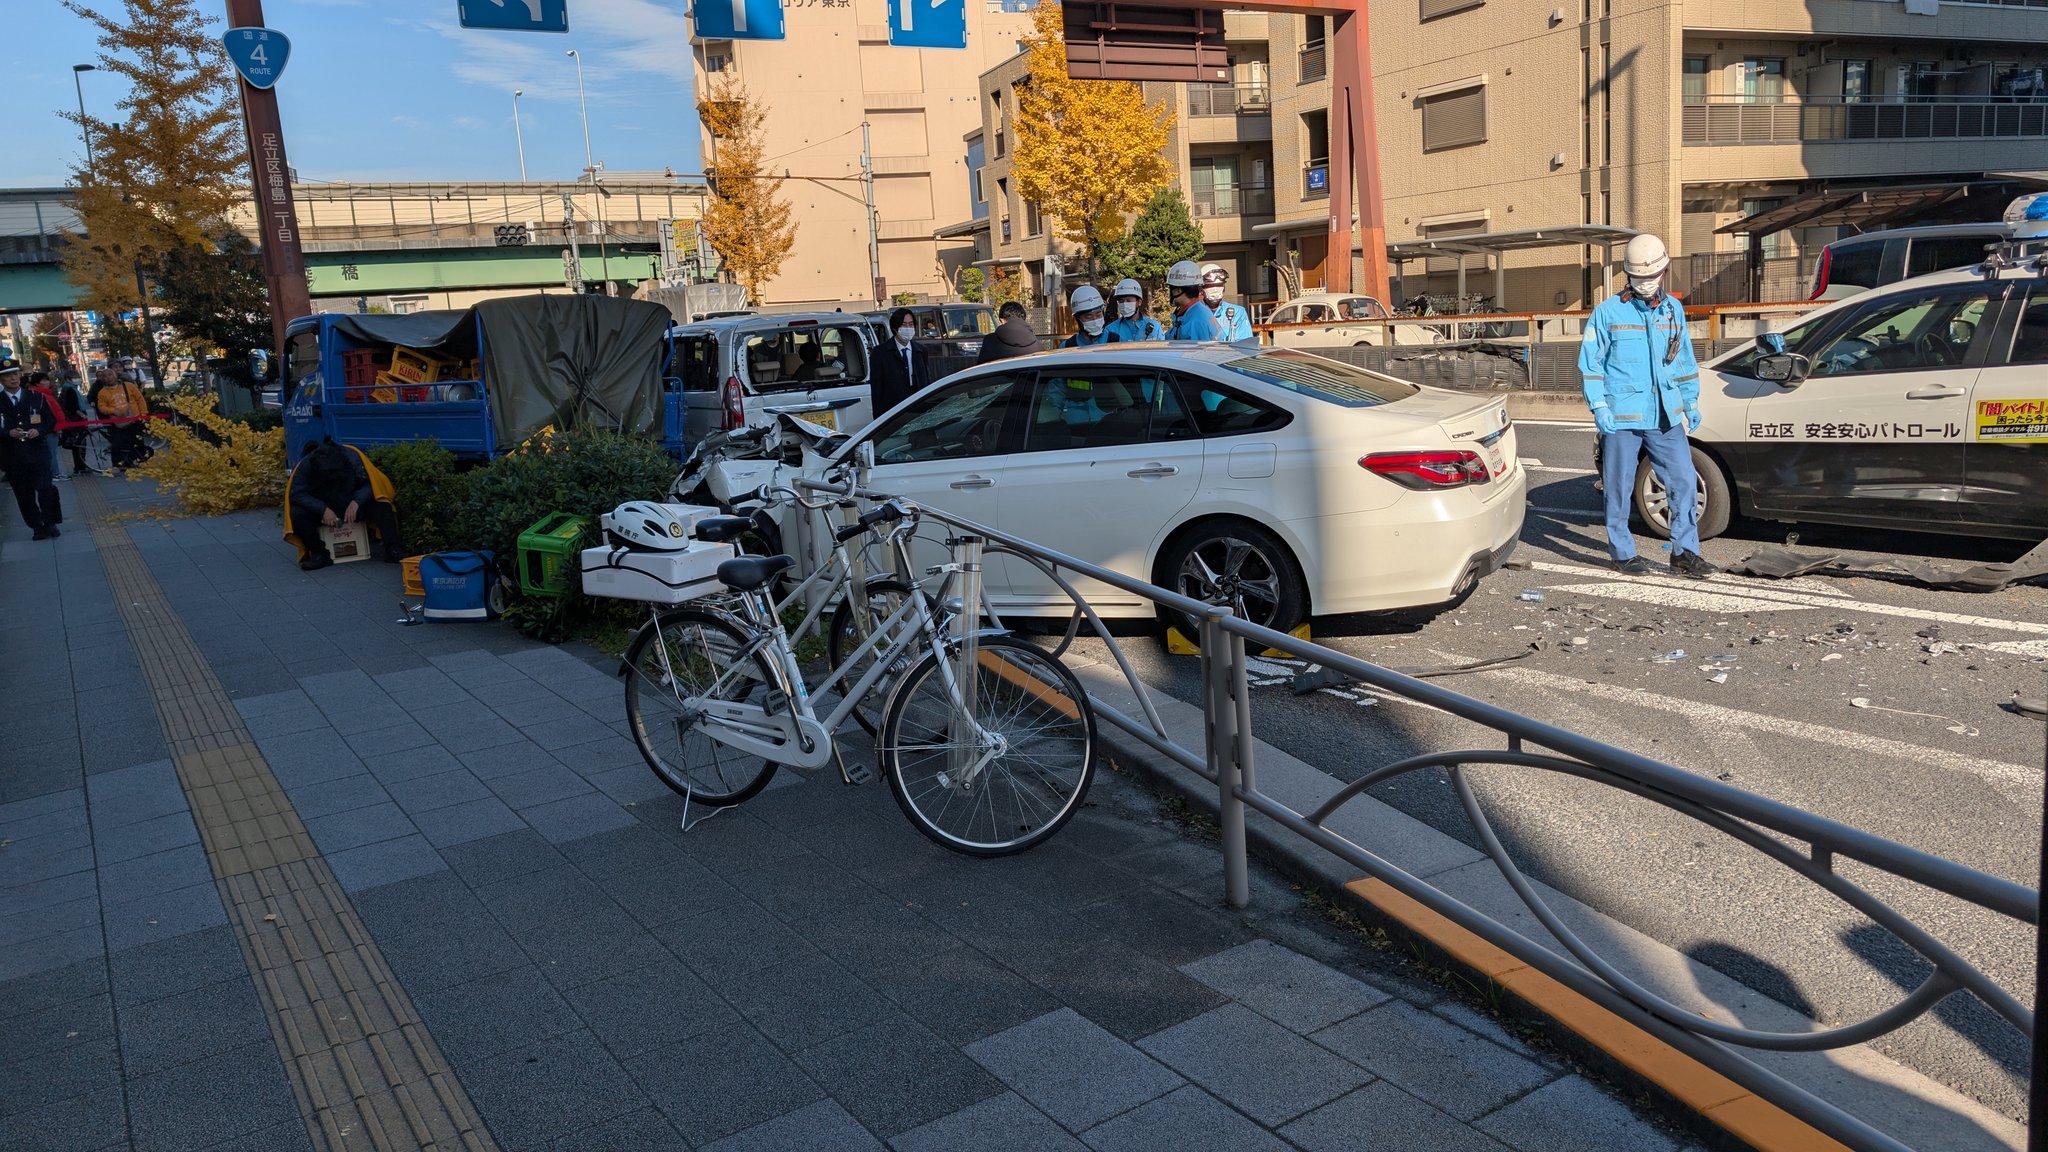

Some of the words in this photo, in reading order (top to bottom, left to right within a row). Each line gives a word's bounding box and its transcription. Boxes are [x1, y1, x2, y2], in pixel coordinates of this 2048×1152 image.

[243, 31, 268, 40] 国道
[250, 44, 268, 65] 4
[262, 133, 293, 242] 足立区梅島二丁目
[399, 364, 423, 381] KIRIN
[291, 405, 313, 416] ARAKI
[1979, 401, 2048, 416] 「闇バイト」
[1749, 423, 1794, 438] 足立区
[1805, 422, 1961, 438] 安全安心パトロール
